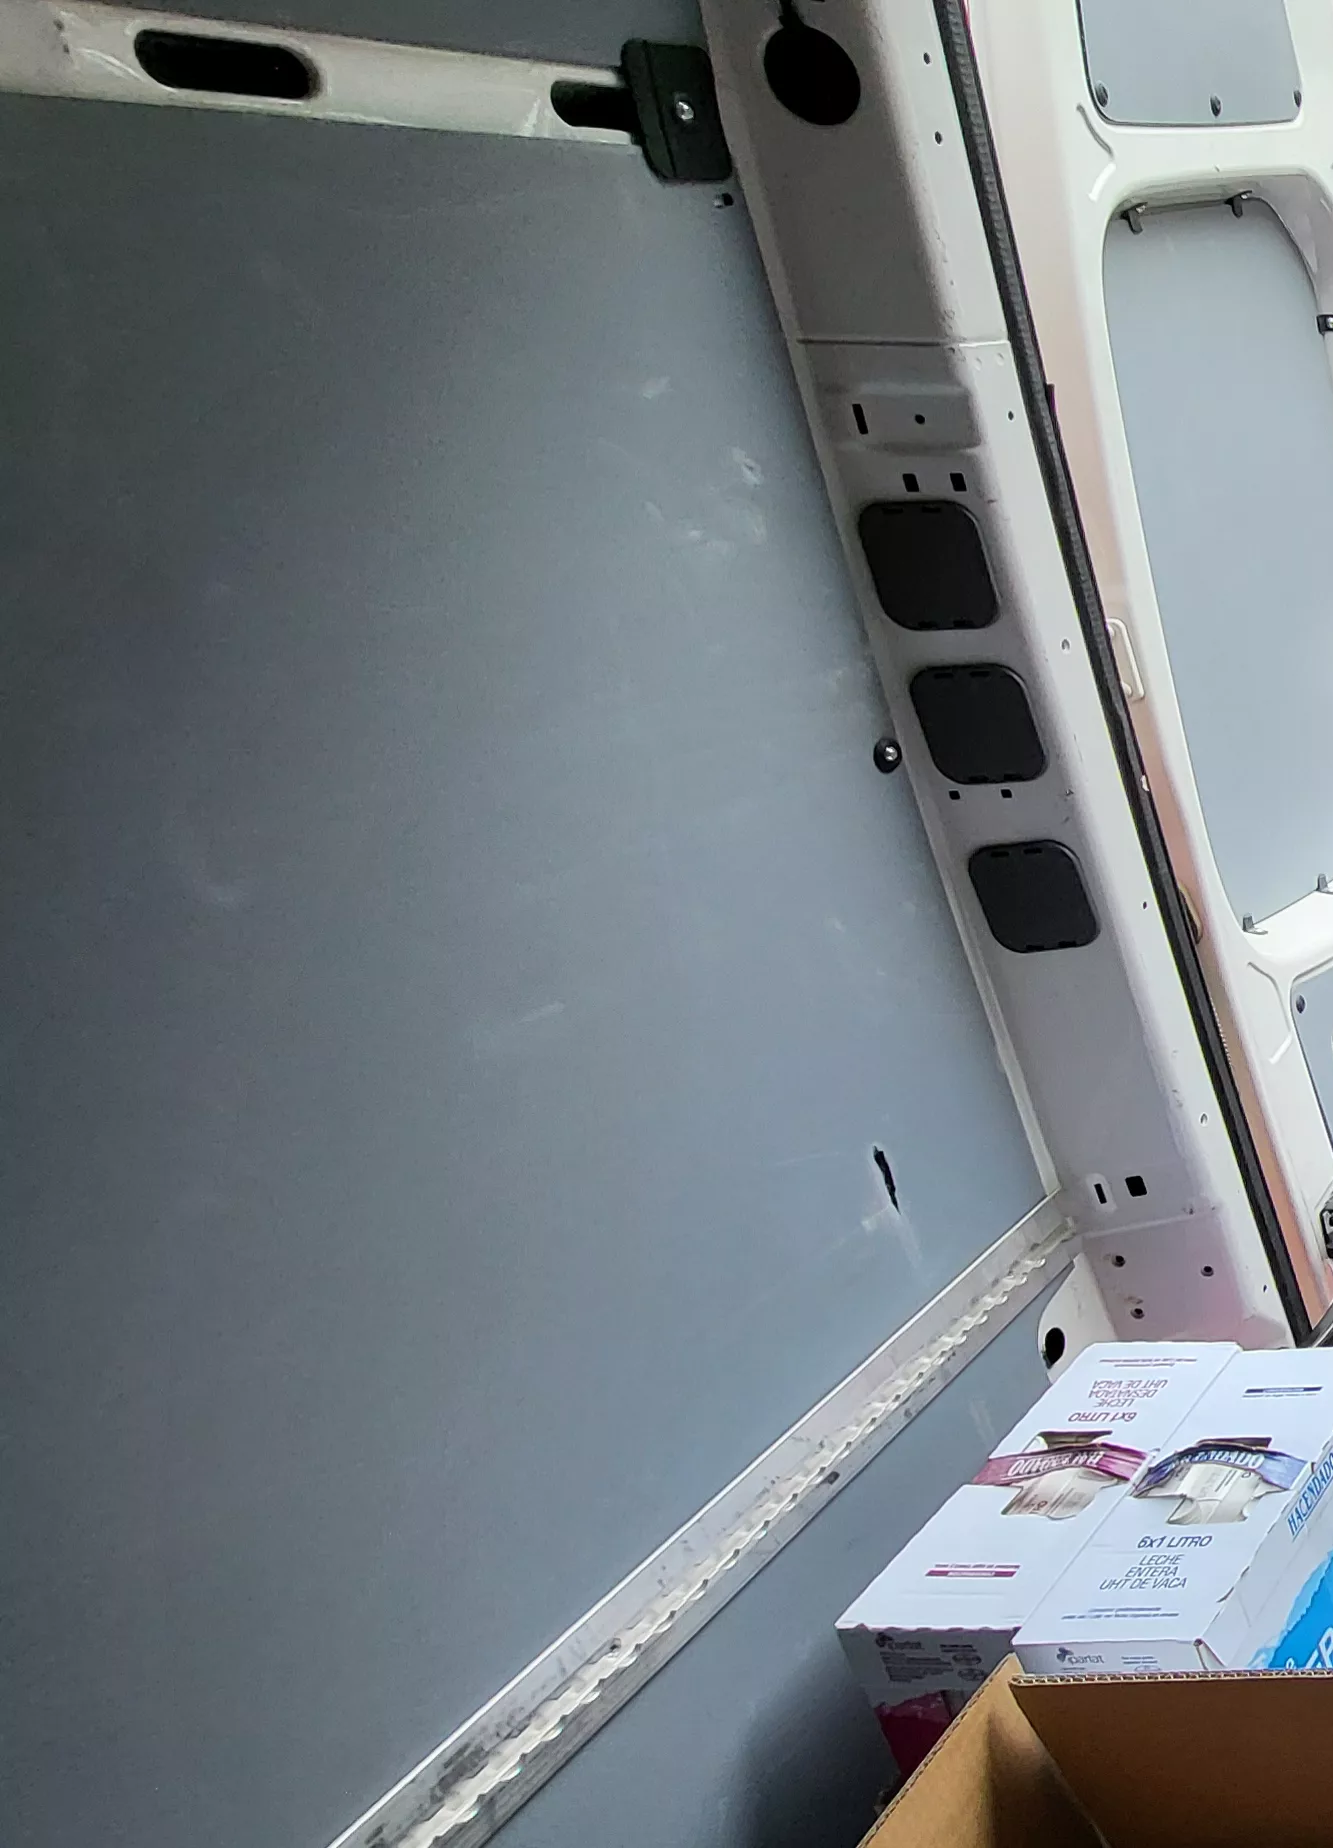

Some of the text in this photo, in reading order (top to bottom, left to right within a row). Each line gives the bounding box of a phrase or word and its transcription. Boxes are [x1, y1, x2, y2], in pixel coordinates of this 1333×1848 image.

[1093, 1399, 1135, 1408] LECHE
[1067, 1411, 1138, 1423] 6x1 LITRO
[1137, 1535, 1213, 1549] 6x1 LITRO
[1139, 1554, 1185, 1566] LECHE
[1125, 1566, 1179, 1577] ENTERA
[1099, 1577, 1187, 1590] UHT DE VACA
